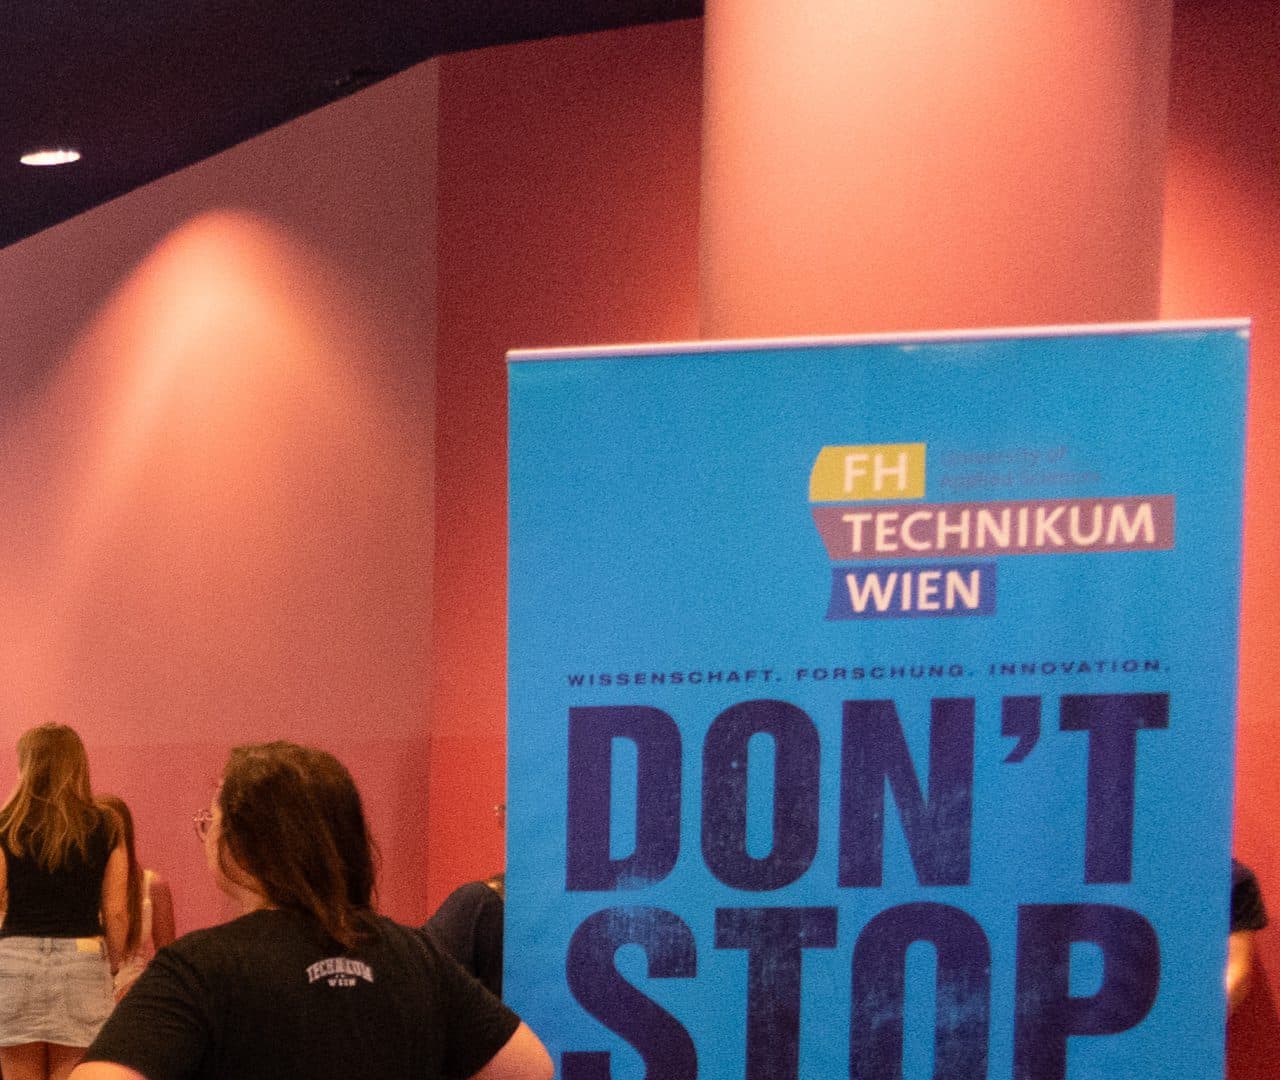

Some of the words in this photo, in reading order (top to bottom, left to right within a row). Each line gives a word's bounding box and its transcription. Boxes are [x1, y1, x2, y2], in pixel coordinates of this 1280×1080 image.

[842, 450, 909, 494] FH
[842, 502, 1155, 553] TECHNIKUM
[846, 569, 980, 613] WIEN
[567, 669, 782, 688] WISSENSCHAFT.
[795, 664, 975, 681] FORSCHUNG.
[989, 659, 1172, 676] INNOVATION.
